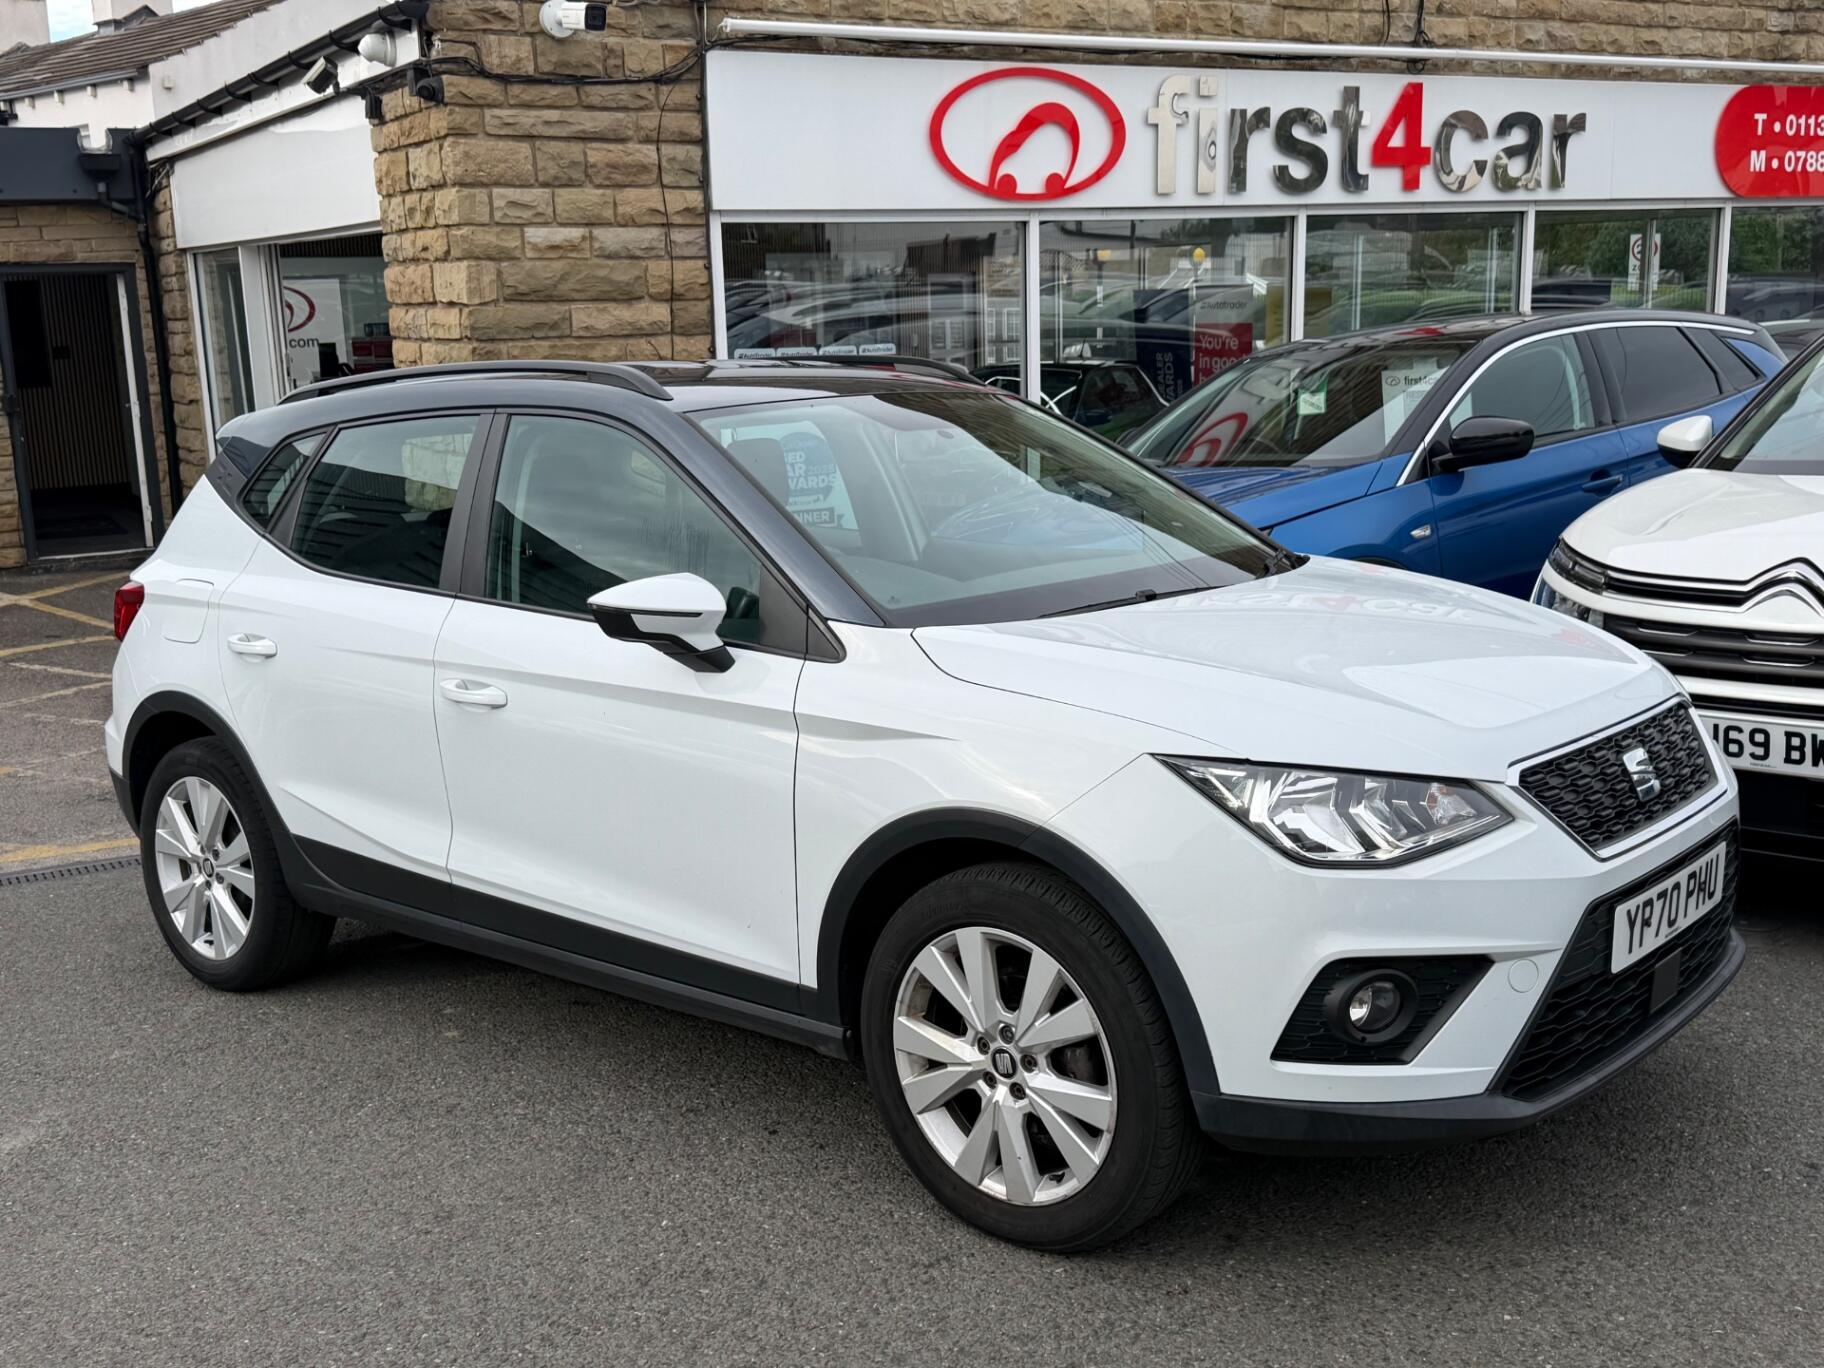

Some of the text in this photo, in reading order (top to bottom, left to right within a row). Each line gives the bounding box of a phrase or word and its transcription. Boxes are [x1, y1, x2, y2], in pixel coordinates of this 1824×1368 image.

[1147, 75, 1587, 194] first4car
[1753, 112, 1824, 137] T 0113
[1749, 149, 1824, 173] M 0788
[1199, 334, 1239, 350] You're
[1626, 853, 1720, 955] YP70 PHU
